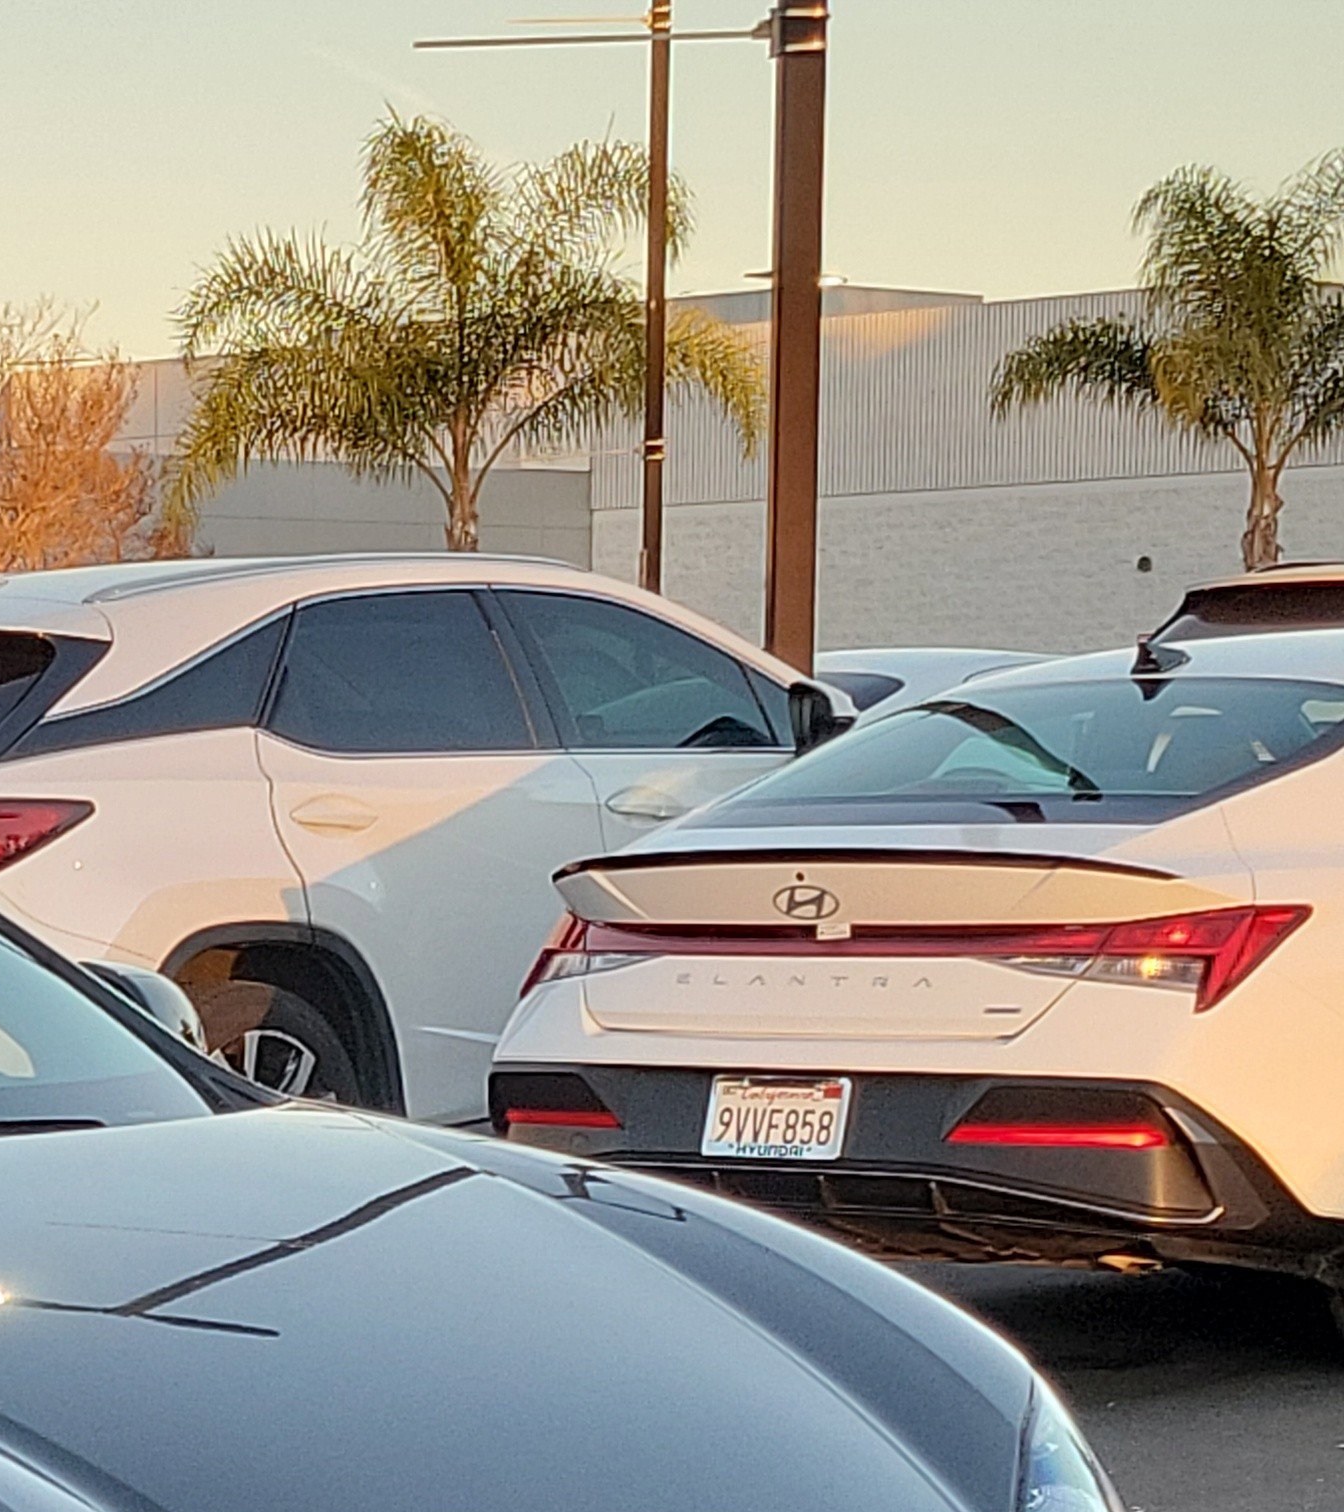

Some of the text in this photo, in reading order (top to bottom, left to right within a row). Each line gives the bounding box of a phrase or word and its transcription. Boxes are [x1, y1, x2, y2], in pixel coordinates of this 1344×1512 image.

[676, 973, 933, 989] ELANTRA
[713, 1106, 835, 1147] 9VVF858
[734, 1143, 806, 1157] HYUNDAI
